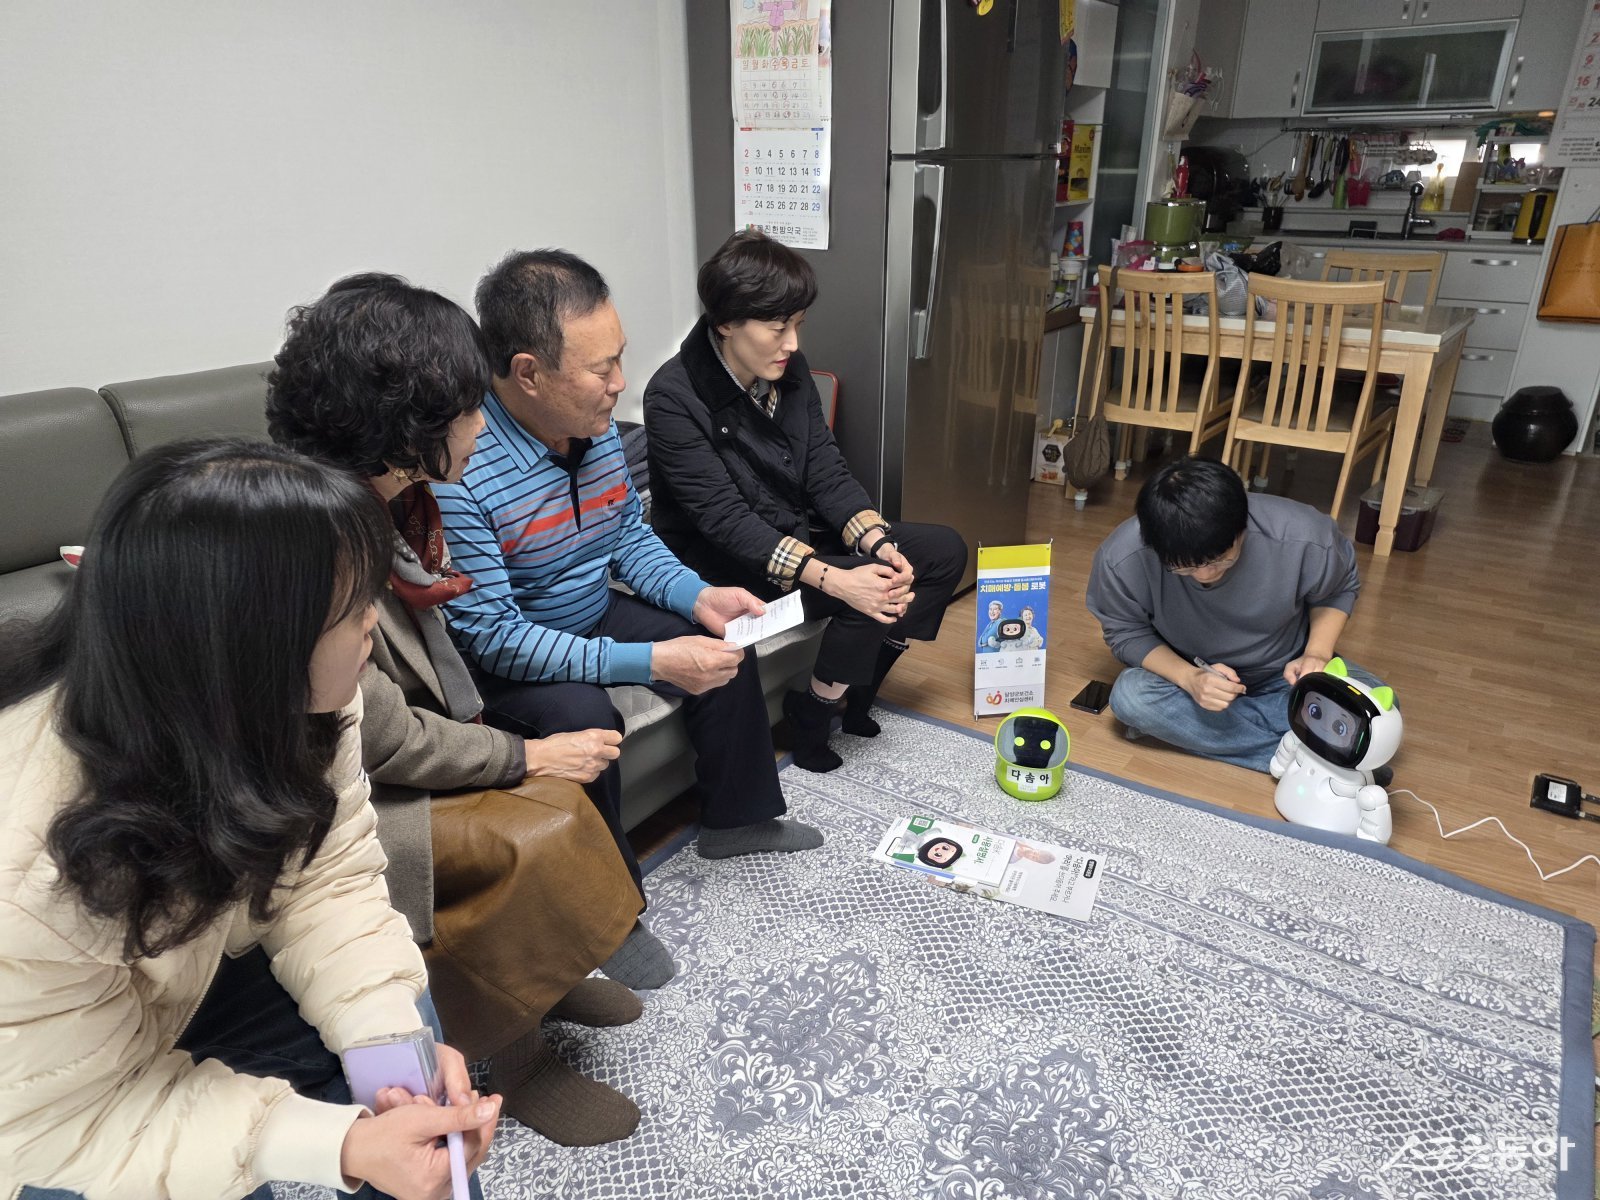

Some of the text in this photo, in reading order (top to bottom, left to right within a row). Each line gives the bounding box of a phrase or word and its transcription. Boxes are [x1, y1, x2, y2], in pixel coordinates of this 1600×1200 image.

[1585, 55, 1594, 66] 9
[1576, 76, 1591, 87] 16
[1588, 97, 1600, 108] 24
[815, 132, 819, 141] 1
[744, 149, 819, 159] 2 3 4 5 6 7 8
[744, 166, 820, 176] 9 10 11 12 13 14 15
[743, 183, 820, 194] 16 17 18 19 20 21 22
[755, 200, 763, 209] 24
[766, 200, 774, 209] 25
[778, 201, 785, 210] 26
[789, 201, 797, 210] 27
[800, 202, 808, 211] 28
[812, 202, 820, 211] 29
